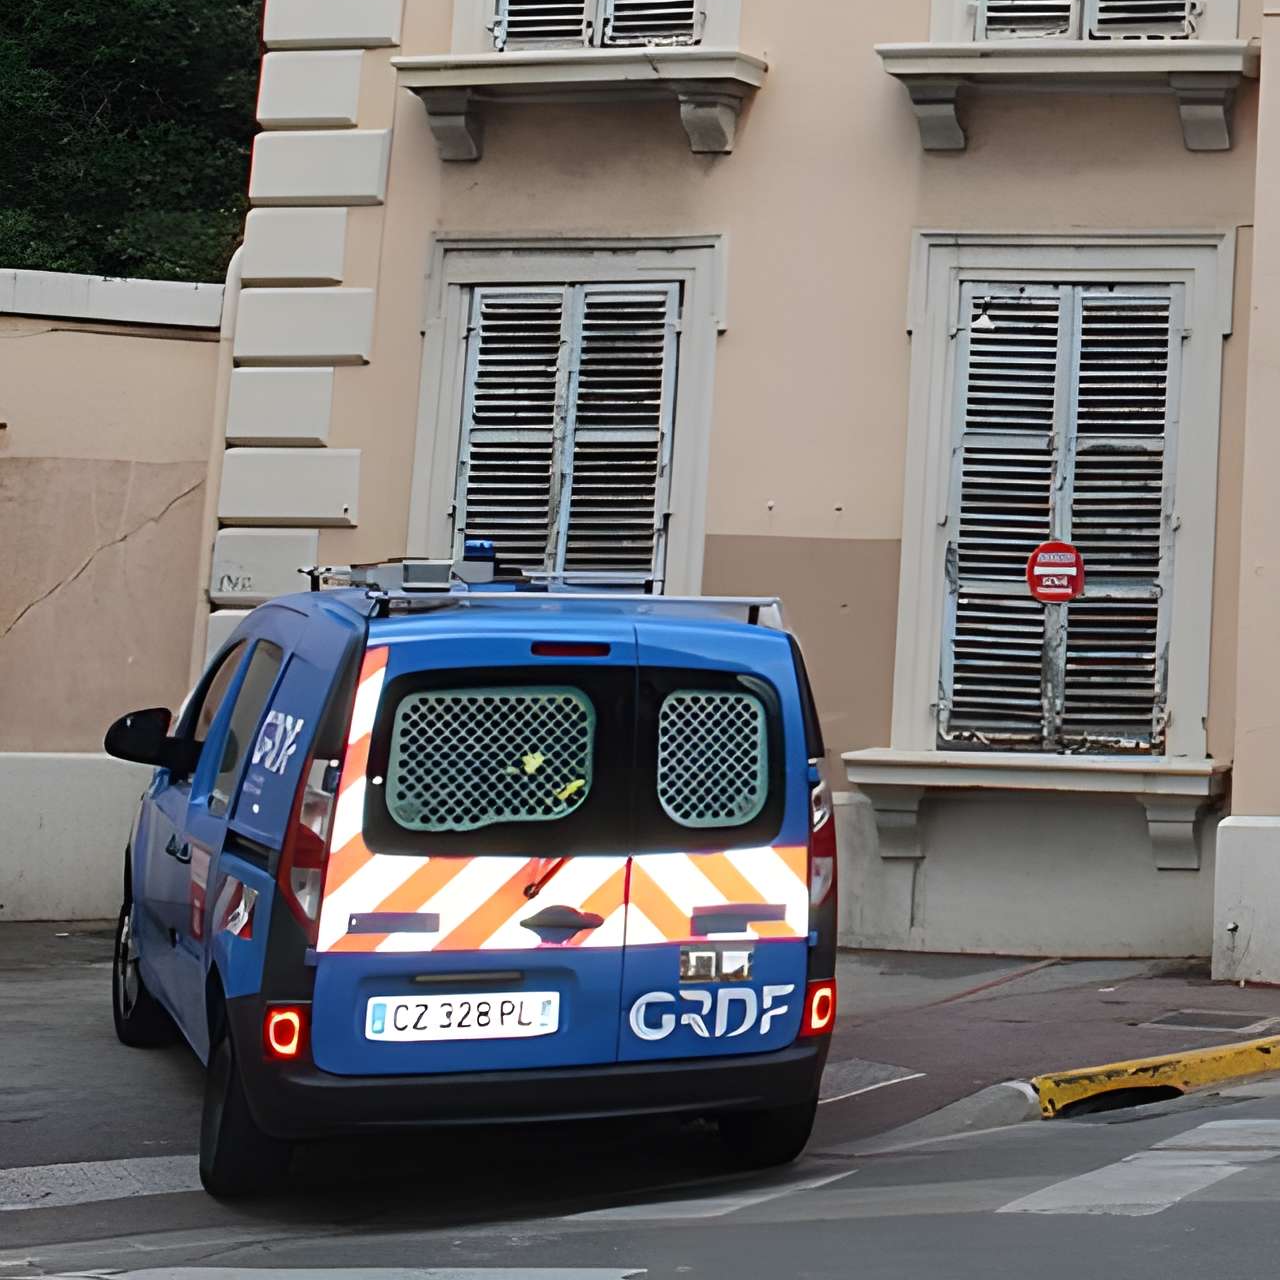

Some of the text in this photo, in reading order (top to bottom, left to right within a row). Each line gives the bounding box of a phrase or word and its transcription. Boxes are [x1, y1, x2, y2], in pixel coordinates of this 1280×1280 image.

[392, 1000, 532, 1032] CZ 328 PL
[629, 983, 796, 1041] GRDF
